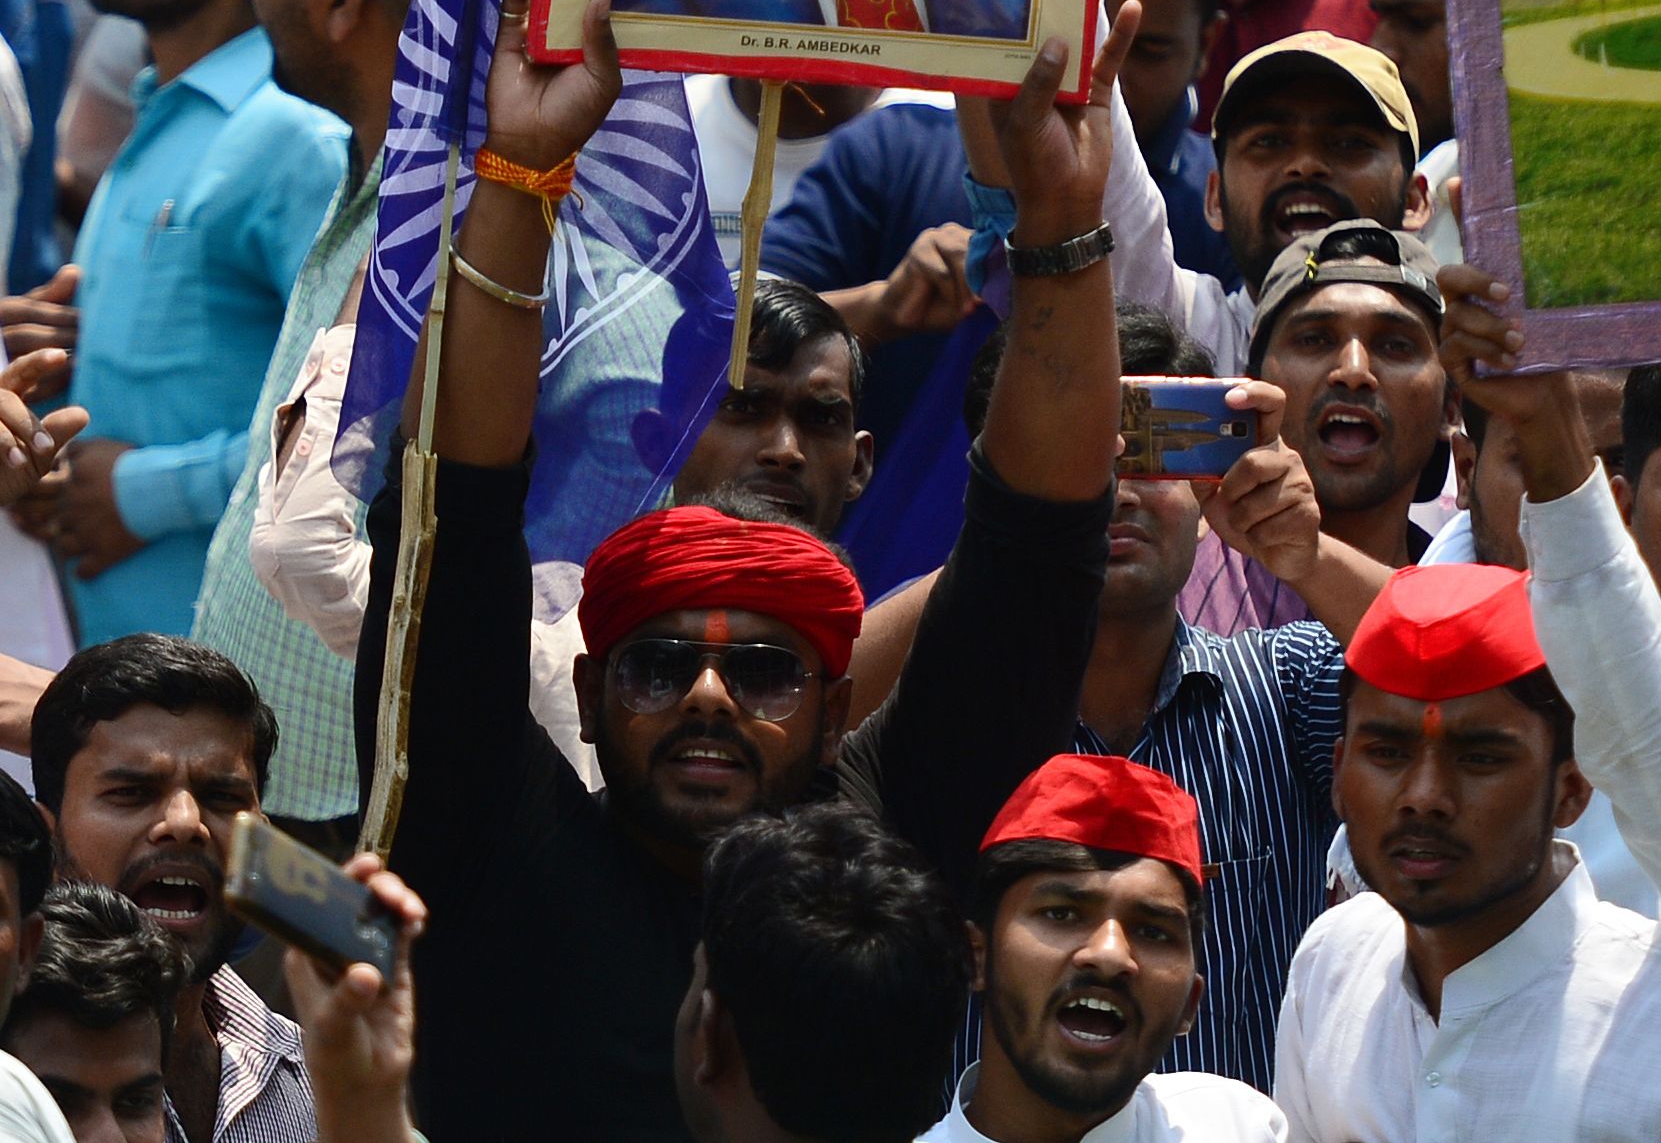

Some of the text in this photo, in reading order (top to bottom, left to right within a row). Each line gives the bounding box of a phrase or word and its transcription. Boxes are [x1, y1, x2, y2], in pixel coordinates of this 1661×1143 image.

[740, 35, 881, 56] Dr. B.R. AMBEDKAR
